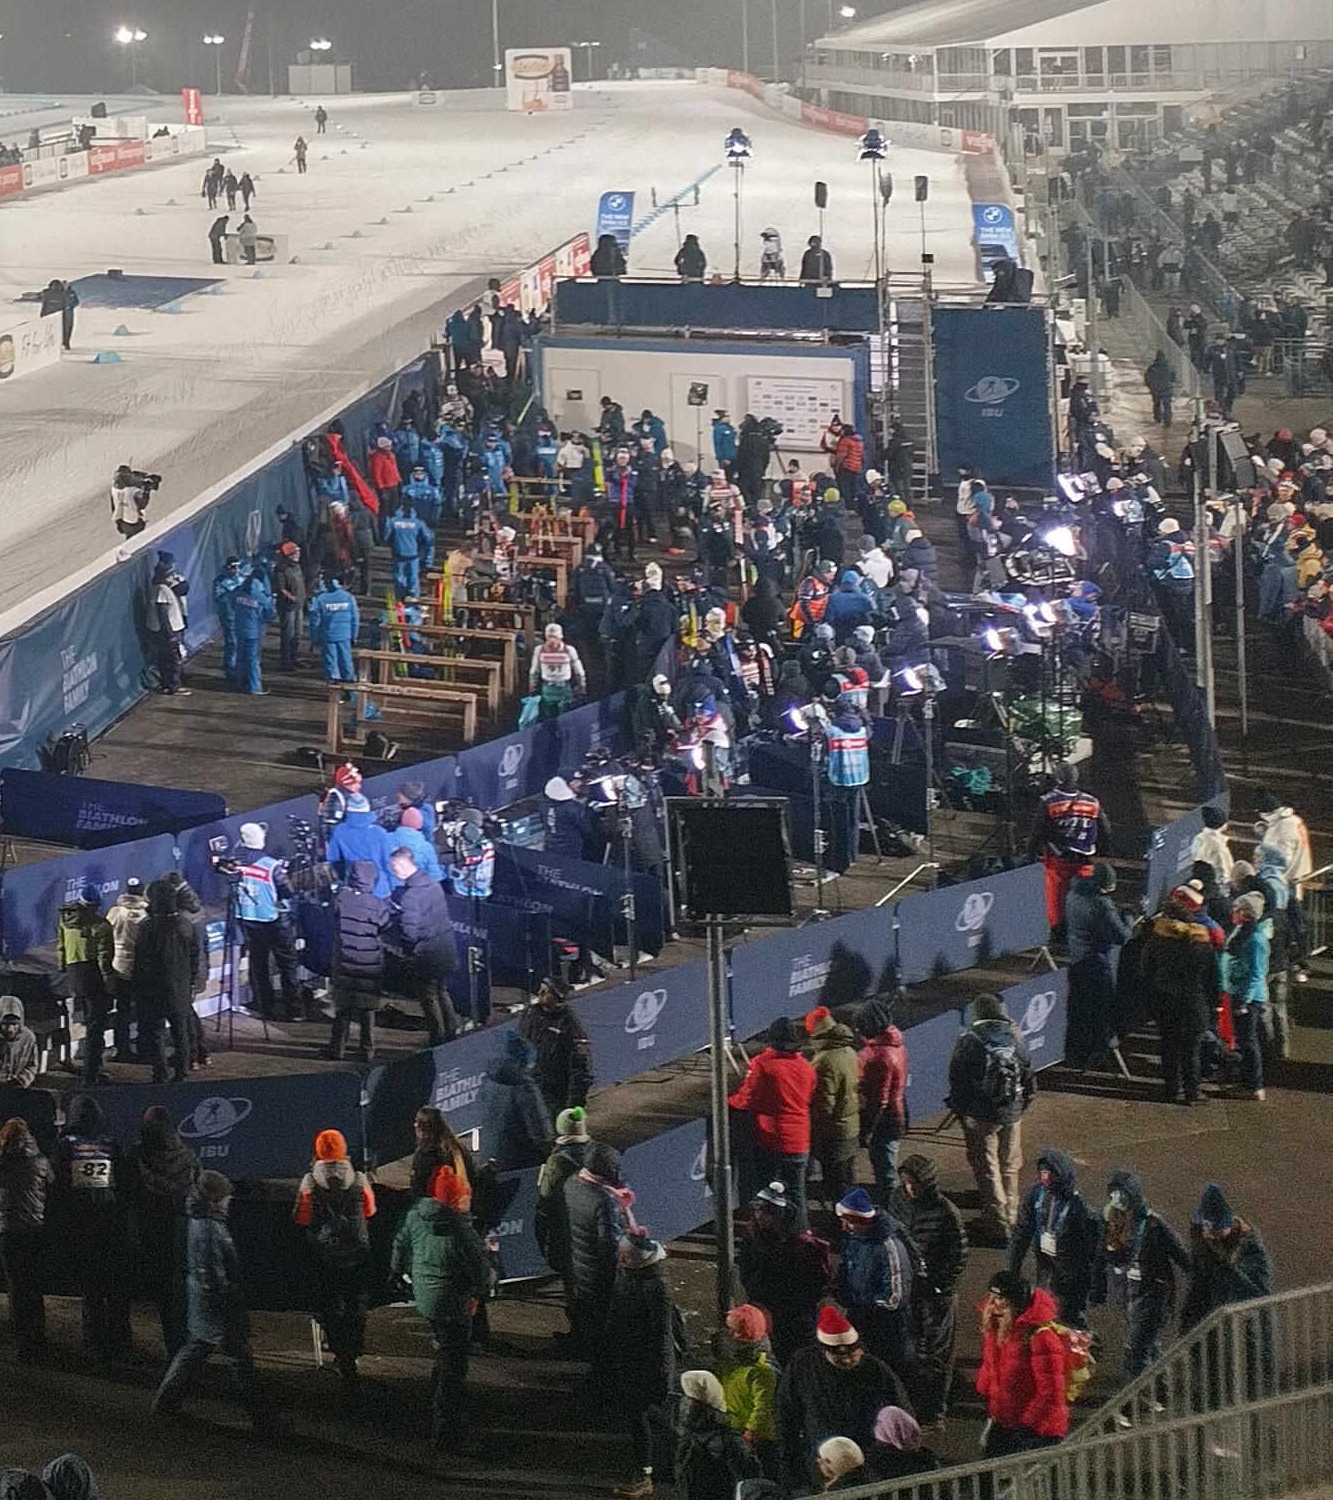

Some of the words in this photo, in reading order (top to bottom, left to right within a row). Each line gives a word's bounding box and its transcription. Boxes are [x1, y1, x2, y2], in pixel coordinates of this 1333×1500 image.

[60, 645, 77, 670] THE
[62, 651, 97, 693] BIATHLON
[63, 679, 90, 715] FAMILY
[200, 1144, 230, 1158] IBU
